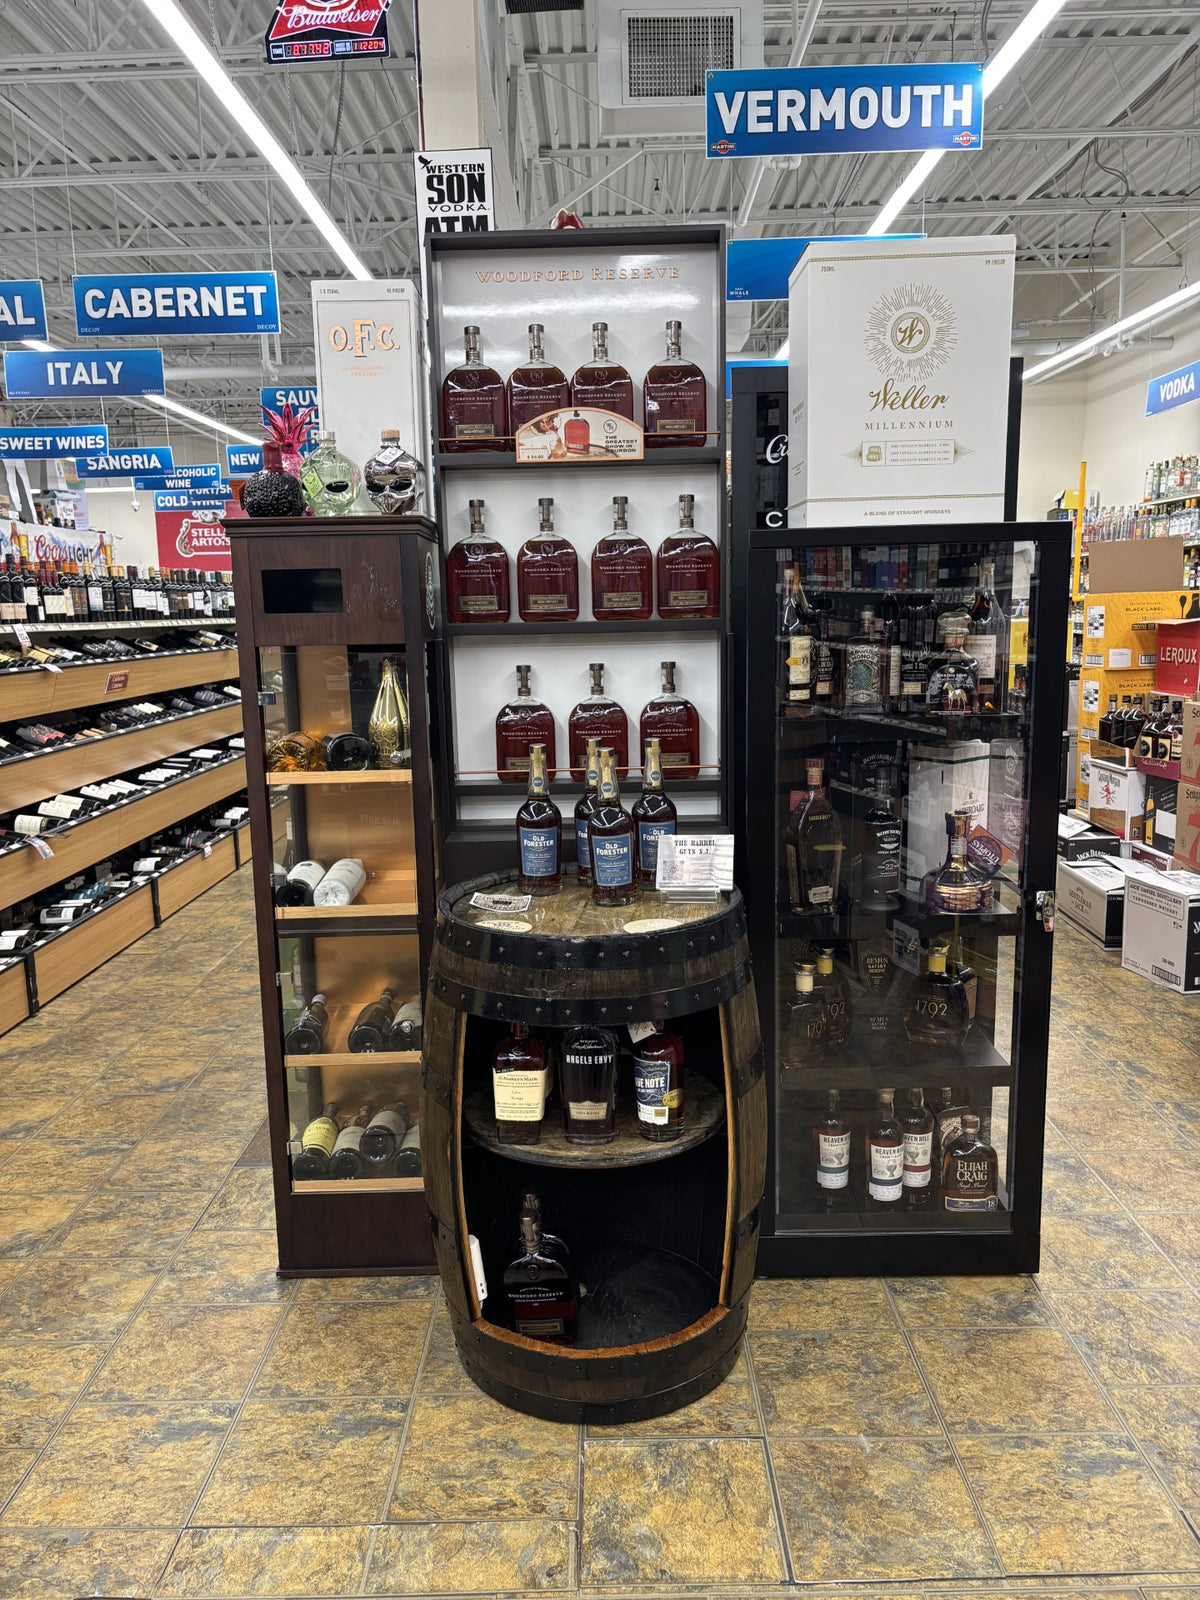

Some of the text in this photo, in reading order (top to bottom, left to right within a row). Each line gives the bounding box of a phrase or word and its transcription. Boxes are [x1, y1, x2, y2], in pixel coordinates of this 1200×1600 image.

[283, 5, 380, 28] Budweiser
[713, 84, 973, 134] VERMOUTH
[953, 135, 979, 143] MARTINI
[711, 143, 736, 151] MARTINI
[426, 163, 485, 174] WESTERN
[426, 173, 486, 204] SON
[428, 204, 485, 212] VODKA
[425, 215, 488, 232] ATM
[476, 267, 680, 283] WOODFORD RESERVE
[84, 286, 267, 319] CABERNET
[329, 320, 400, 357] O.F.C.
[47, 362, 123, 385] ITALY
[1160, 372, 1195, 402] VODKA
[869, 378, 950, 412] Weller
[865, 420, 953, 430] MILLENNIUM
[0, 435, 105, 450] SWEET WINES
[87, 454, 161, 470] SANGRIA
[230, 453, 259, 465] NEW
[165, 479, 191, 488] WINE
[157, 496, 187, 506] COLD
[34, 535, 94, 562] Coors LIGHT
[1160, 647, 1198, 666] LEROUX
[523, 839, 554, 847] FORESTER
[596, 847, 628, 855] FORESTER
[971, 839, 1000, 864] UTOPIAS
[916, 1000, 948, 1019] 1792
[594, 1054, 613, 1064] ENVY
[645, 1076, 665, 1088] NOTE
[957, 1160, 988, 1171] ELIJAH
[956, 1171, 988, 1182] CRAIG
[987, 1200, 995, 1208] 18
